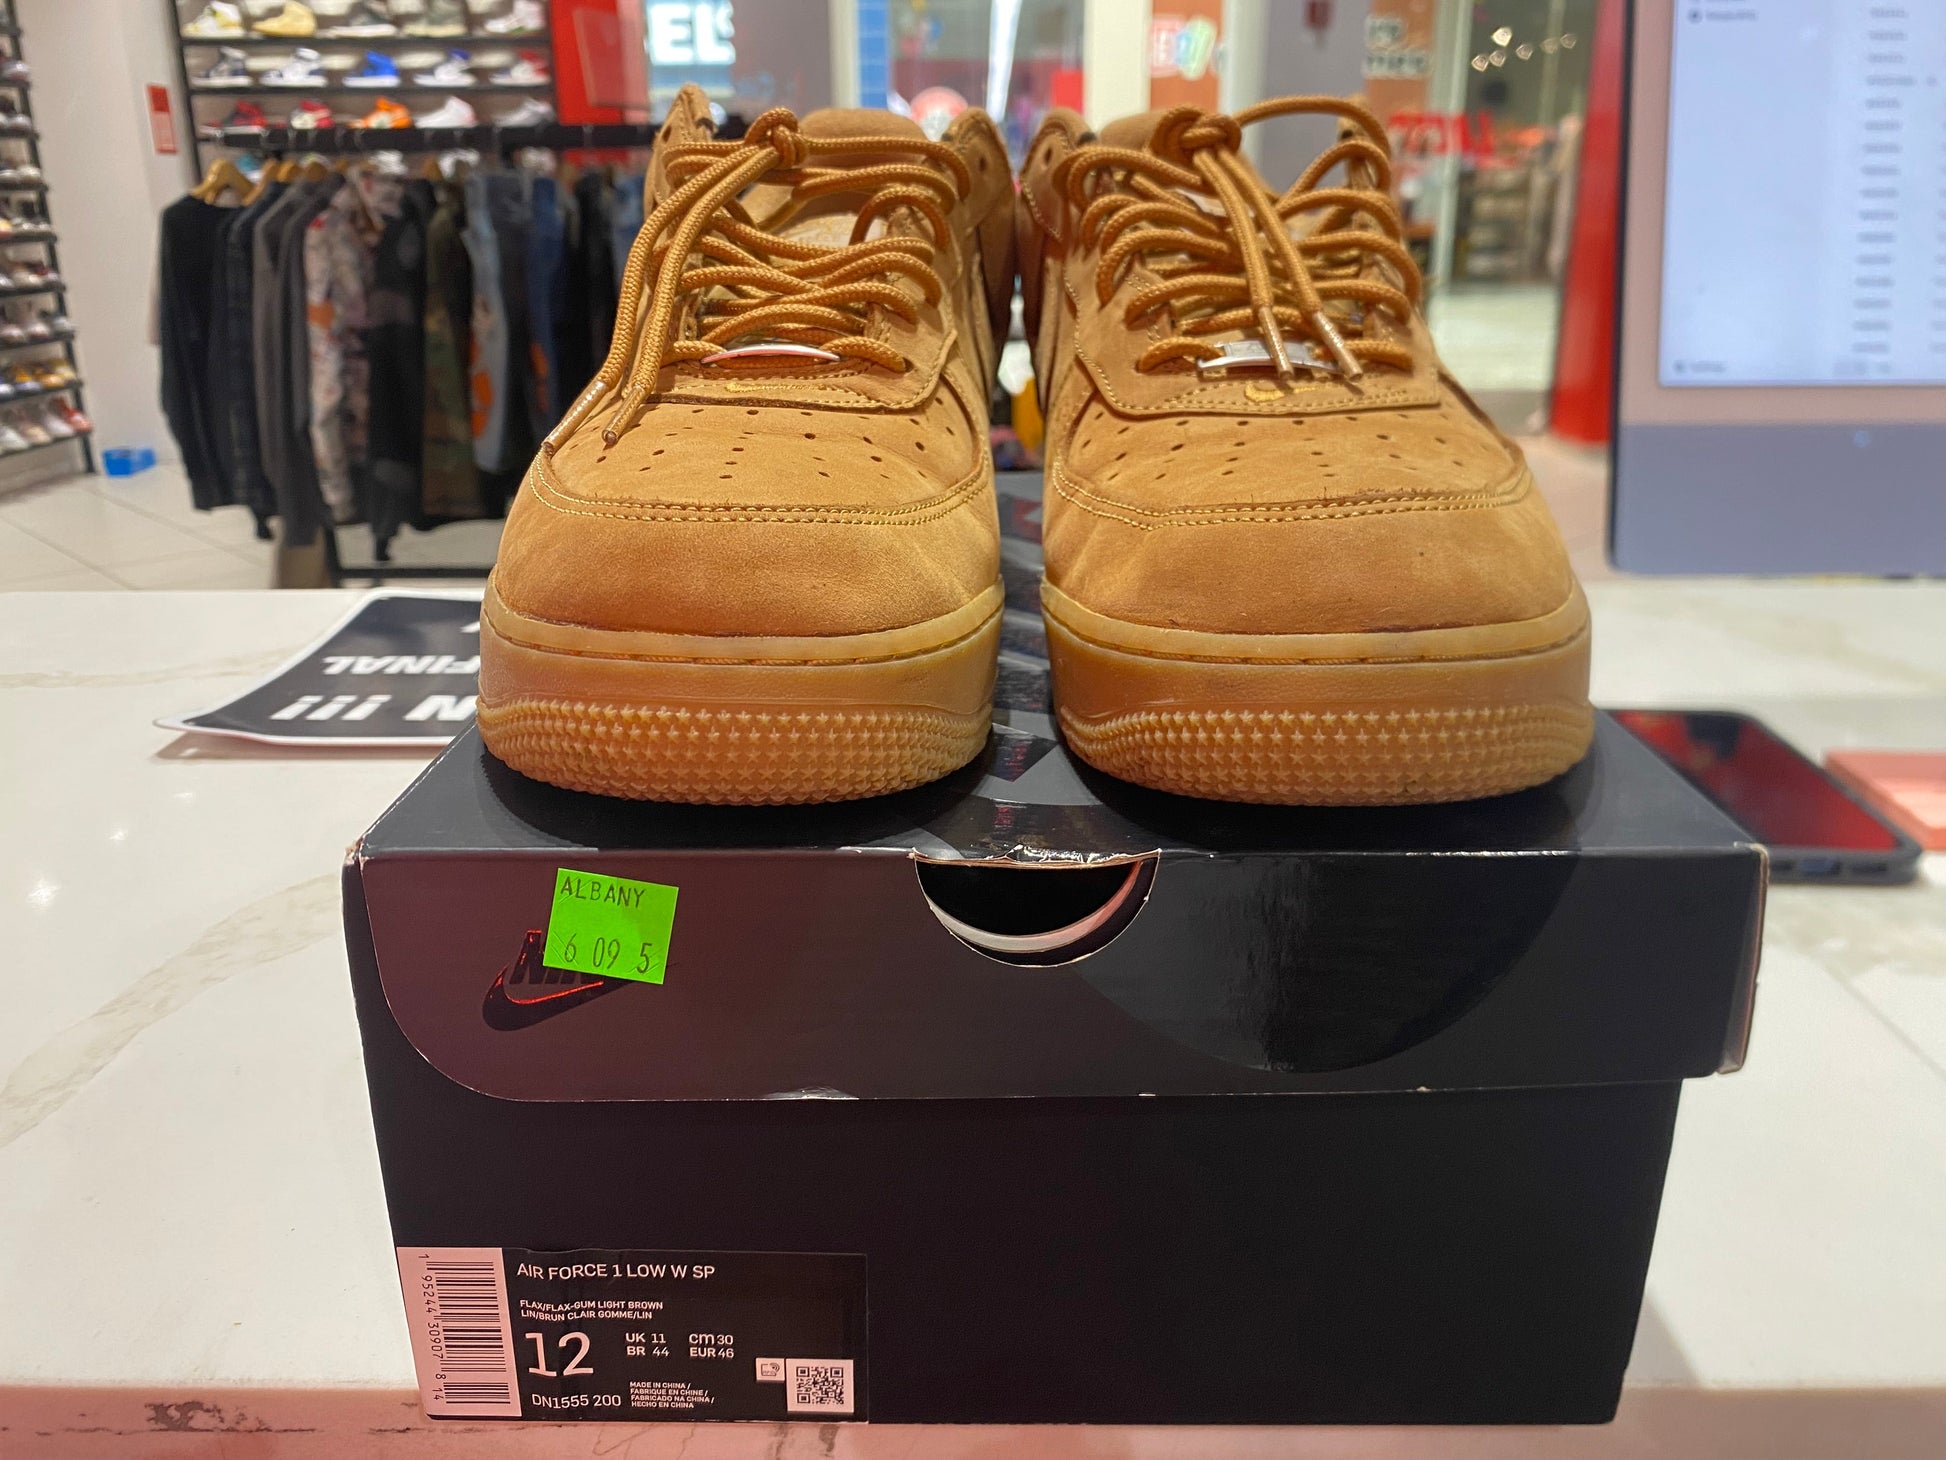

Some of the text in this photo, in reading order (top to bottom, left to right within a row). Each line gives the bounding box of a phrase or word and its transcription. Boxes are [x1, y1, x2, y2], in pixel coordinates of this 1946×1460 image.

[322, 656, 481, 674] FINAL
[560, 876, 645, 908] ALBANY
[516, 1263, 716, 1280] AIR FORCE 1 LOW W SP
[421, 1275, 437, 1314] 95244
[520, 1300, 664, 1312] FLAX/FLAX-GUM LIGHT BROWN
[521, 1310, 653, 1321] LIN/BRUN CLAIR GOMME/LIN
[427, 1322, 444, 1359] 30907
[625, 1332, 667, 1344] UK 11
[717, 1334, 734, 1345] 30
[525, 1331, 594, 1377] 12
[627, 1346, 670, 1357] BR 44
[690, 1347, 735, 1358] EUR 46
[432, 1387, 444, 1401] 14
[532, 1394, 622, 1409] DN1555 200
